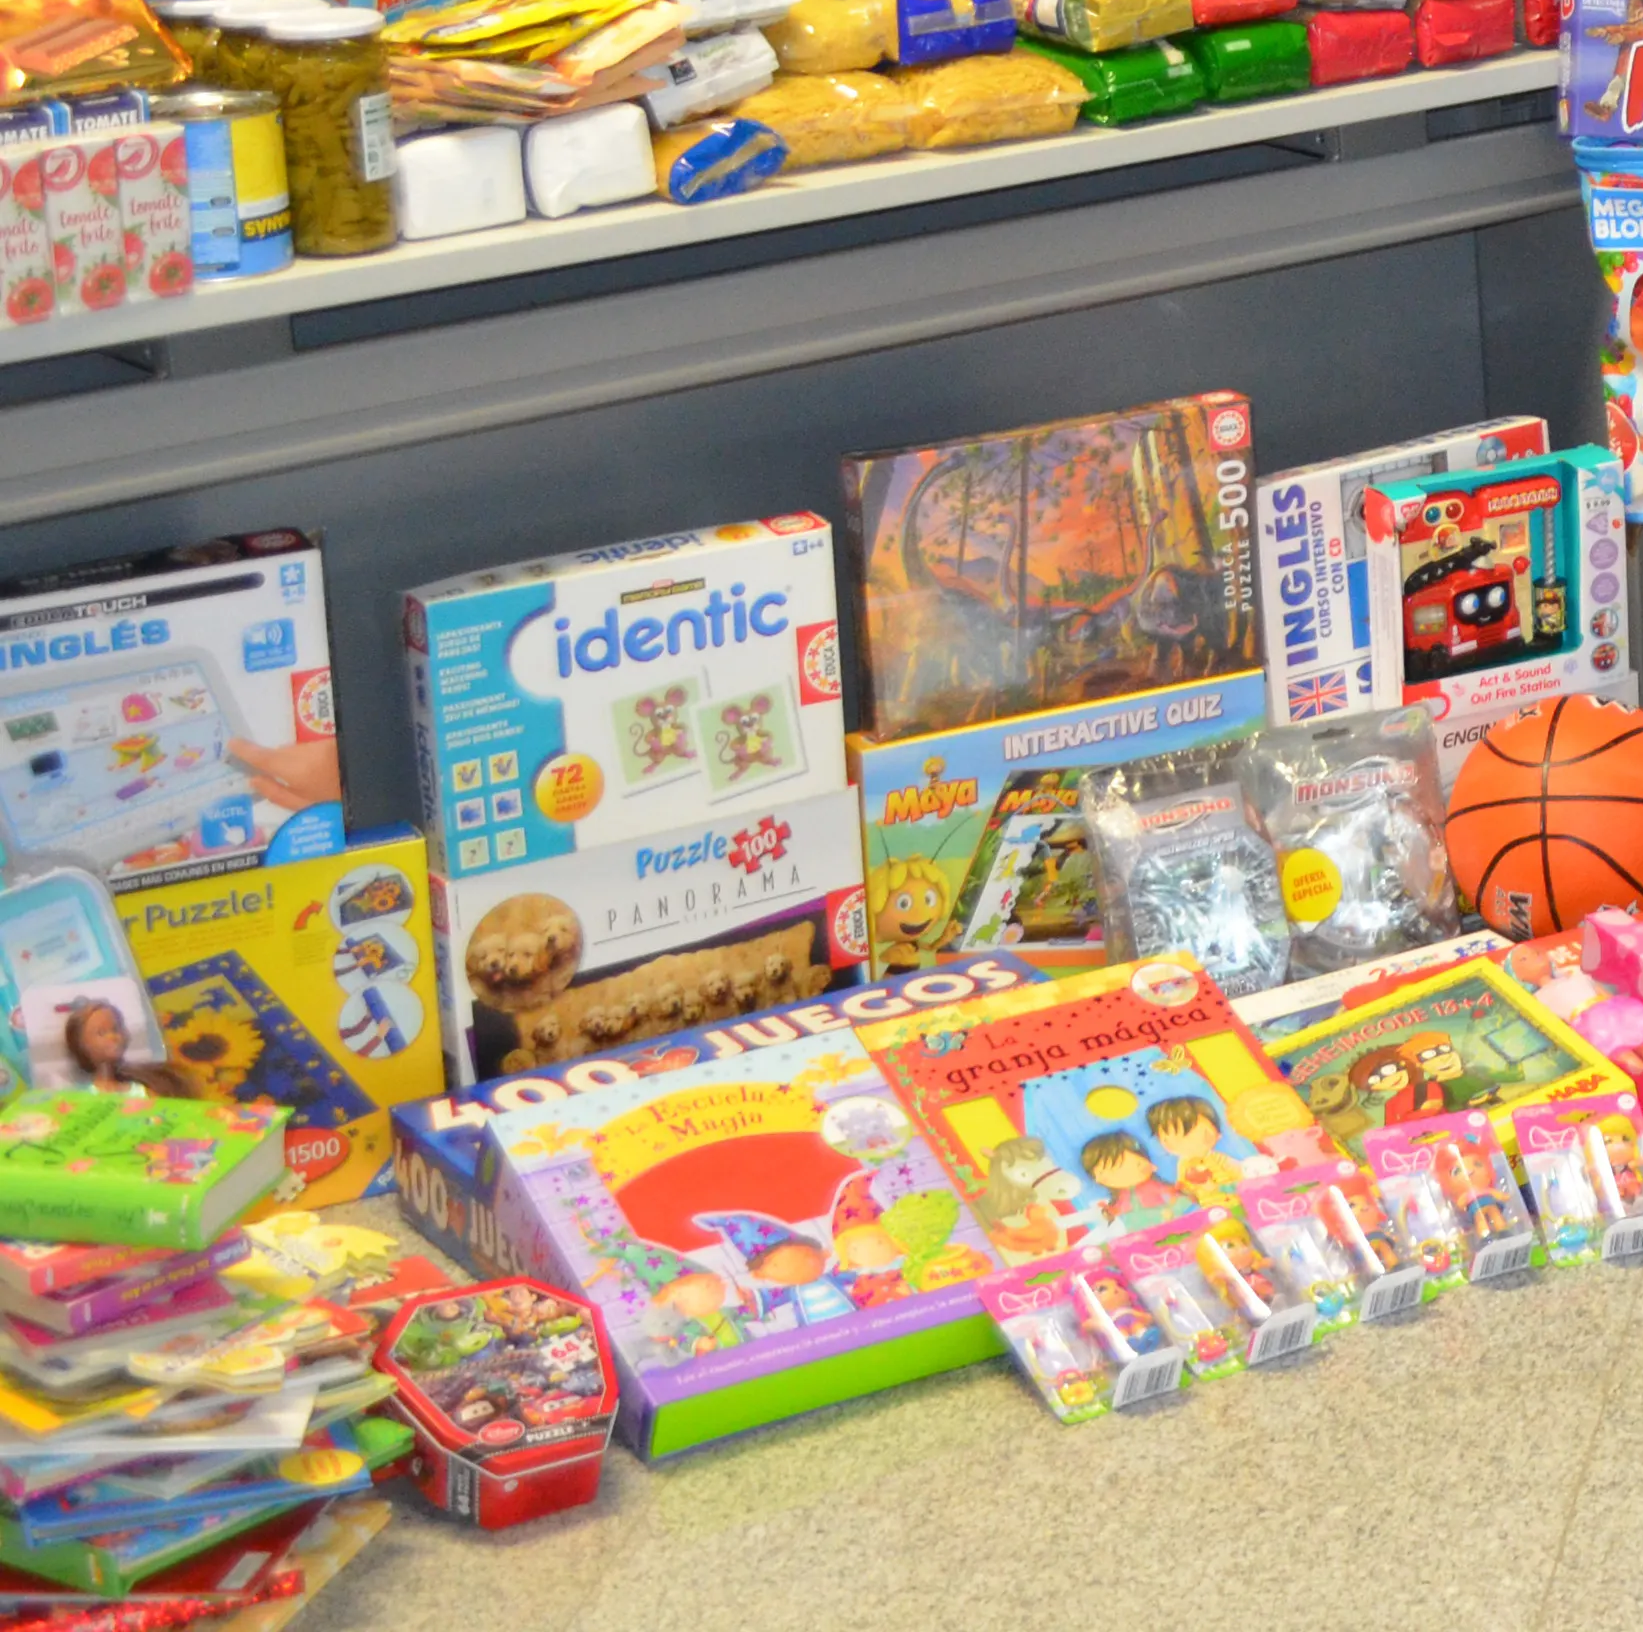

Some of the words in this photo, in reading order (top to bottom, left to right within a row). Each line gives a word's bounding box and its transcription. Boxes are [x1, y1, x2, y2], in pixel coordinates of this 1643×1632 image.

[75, 110, 139, 131] TOMATE
[59, 206, 114, 227] tomate
[129, 194, 182, 217] tomate
[80, 220, 114, 253] frito
[149, 213, 182, 241] frito
[4, 236, 40, 263] frito
[1216, 458, 1249, 531] 500
[1308, 500, 1328, 581] INTENSIVO
[1328, 536, 1343, 559] CD
[1222, 540, 1238, 610] EDUCA
[1240, 539, 1254, 613] PUZZLE
[1265, 482, 1320, 668] INGLÉS
[1332, 561, 1346, 595] CON
[1318, 583, 1334, 640] CURSO
[553, 581, 790, 680] identic
[1470, 690, 1492, 705] Out
[1495, 685, 1516, 701] Fire
[1518, 677, 1561, 697] Station
[1479, 673, 1501, 689] Act
[1502, 672, 1512, 684] &
[1513, 662, 1552, 683] Sound
[1003, 704, 1159, 761] INTERACTIVE
[1165, 693, 1223, 728] QUIZ
[551, 763, 585, 786] 72
[883, 775, 980, 826] Maya
[634, 830, 728, 881] Puzzle
[740, 829, 778, 861] 100
[607, 863, 803, 928] PANORAMA
[1291, 868, 1327, 890] OFERTA
[1291, 879, 1335, 904] ESPECIAL
[145, 883, 275, 930] Puzzle!
[427, 1058, 642, 1131] 400
[702, 958, 1024, 1061] JUEGOS
[944, 1038, 1069, 1094] granja
[1080, 1004, 1212, 1055] mágica
[1545, 1069, 1611, 1102] HABA
[667, 1109, 764, 1143] Magia
[287, 1138, 341, 1165] 1500
[526, 1422, 574, 1444] PUZZLE
